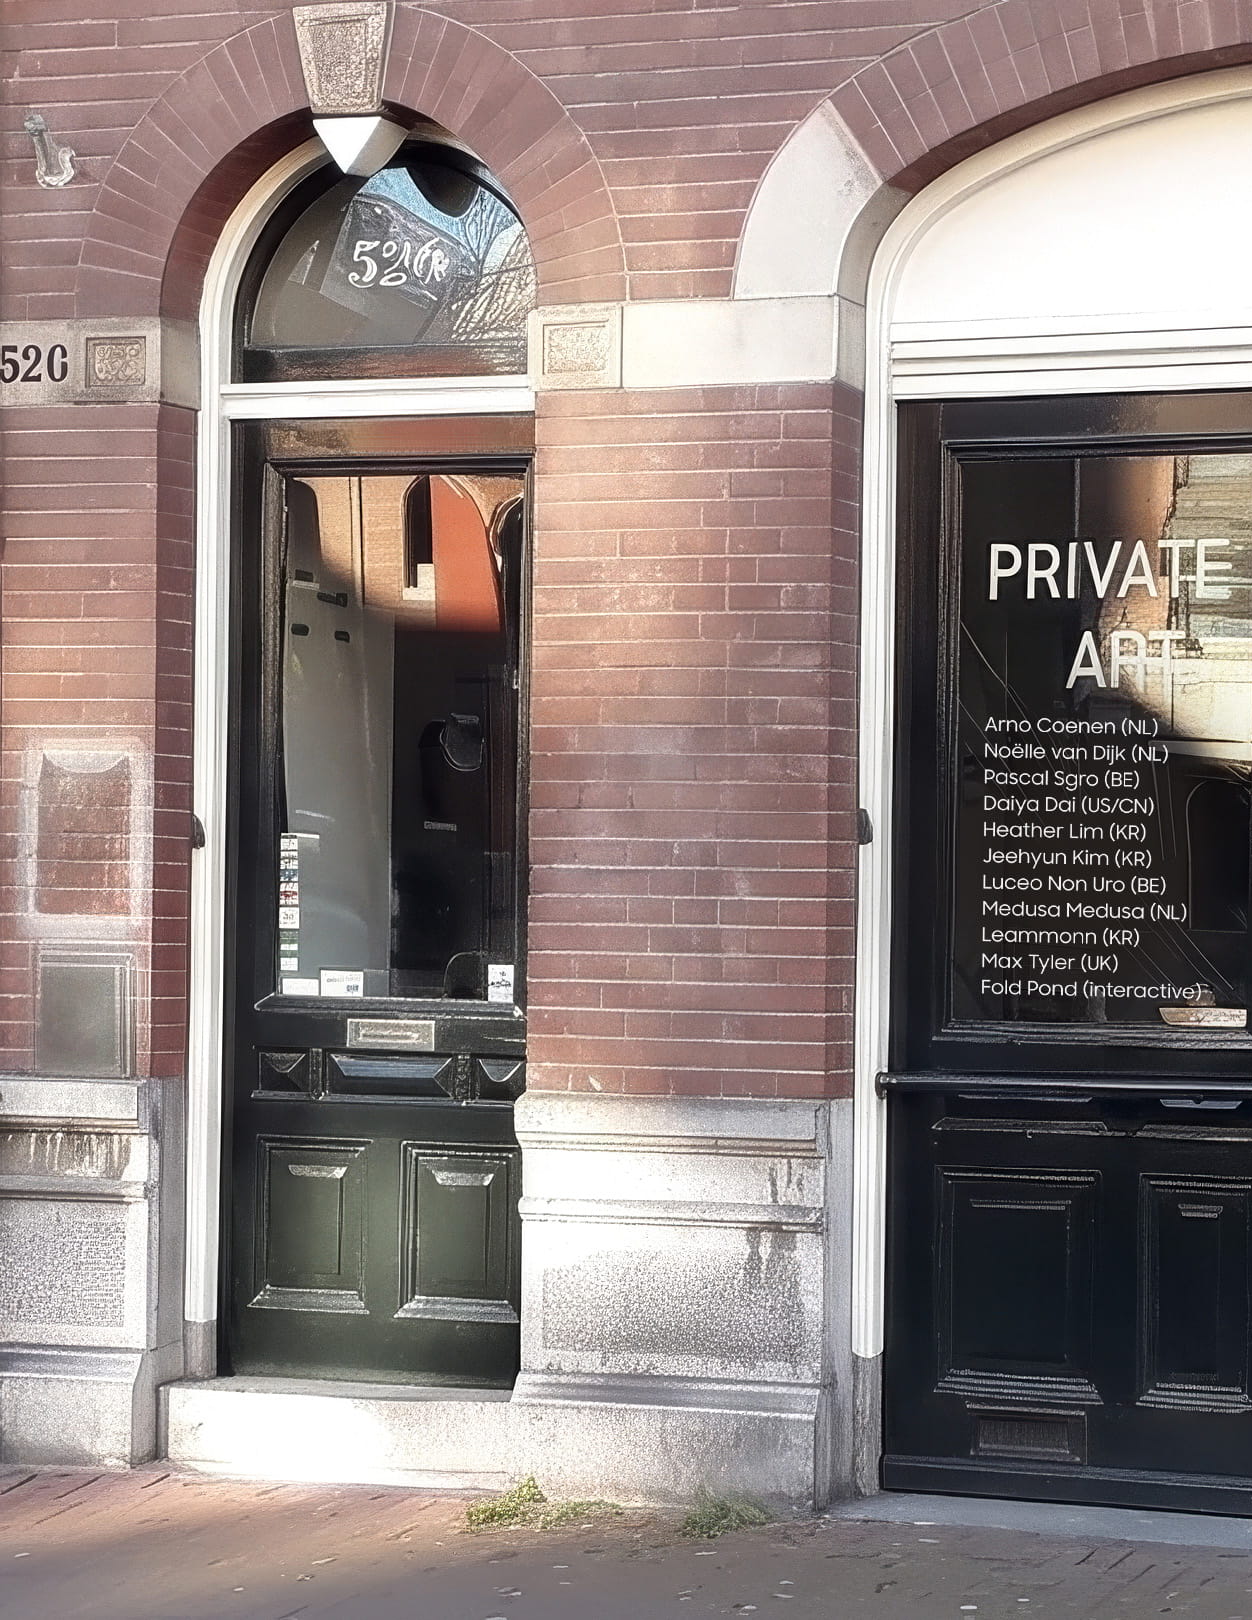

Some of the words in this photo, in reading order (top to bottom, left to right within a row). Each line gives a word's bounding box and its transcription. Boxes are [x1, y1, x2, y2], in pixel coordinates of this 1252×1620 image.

[988, 538, 1233, 601] PRIVATE
[1066, 630, 1186, 690] ART
[984, 716, 1032, 733] Arno
[1036, 717, 1116, 734] Coenen
[1121, 717, 1159, 738] (NL)
[984, 742, 1046, 759] Noëlle
[1051, 747, 1088, 761] van
[1093, 744, 1126, 766] Dijk
[1131, 743, 1169, 764] (NL)
[984, 768, 1049, 786] Pascal
[1054, 770, 1099, 792] Sgro
[1104, 769, 1140, 790] (BE)
[983, 795, 1039, 816] Daiya
[1045, 796, 1076, 813] Dai
[1081, 795, 1155, 817] (US/CN)
[983, 821, 1065, 839] Heather
[1069, 823, 1104, 840] Lim
[1109, 822, 1146, 843] (KR)
[983, 847, 1067, 870] Jeehyun
[1072, 849, 1109, 866] Kim
[1114, 848, 1152, 869] (KR)
[982, 874, 1043, 891] Luceo
[1048, 875, 1087, 892] Non
[1093, 876, 1126, 893] Uro
[1130, 875, 1167, 896] (BE)
[982, 900, 1061, 918] Medusa
[1066, 902, 1145, 920] Medusa
[1150, 902, 1187, 923] (NL)
[982, 926, 1097, 945] Leammonn
[1102, 927, 1140, 948] (KR)
[981, 952, 1023, 969] Max
[1028, 954, 1076, 975] Tyler
[1080, 953, 1119, 974] (UK)
[981, 979, 1022, 996] Fold
[1027, 980, 1078, 997] Pond
[1082, 979, 1204, 1002] (interactive)
